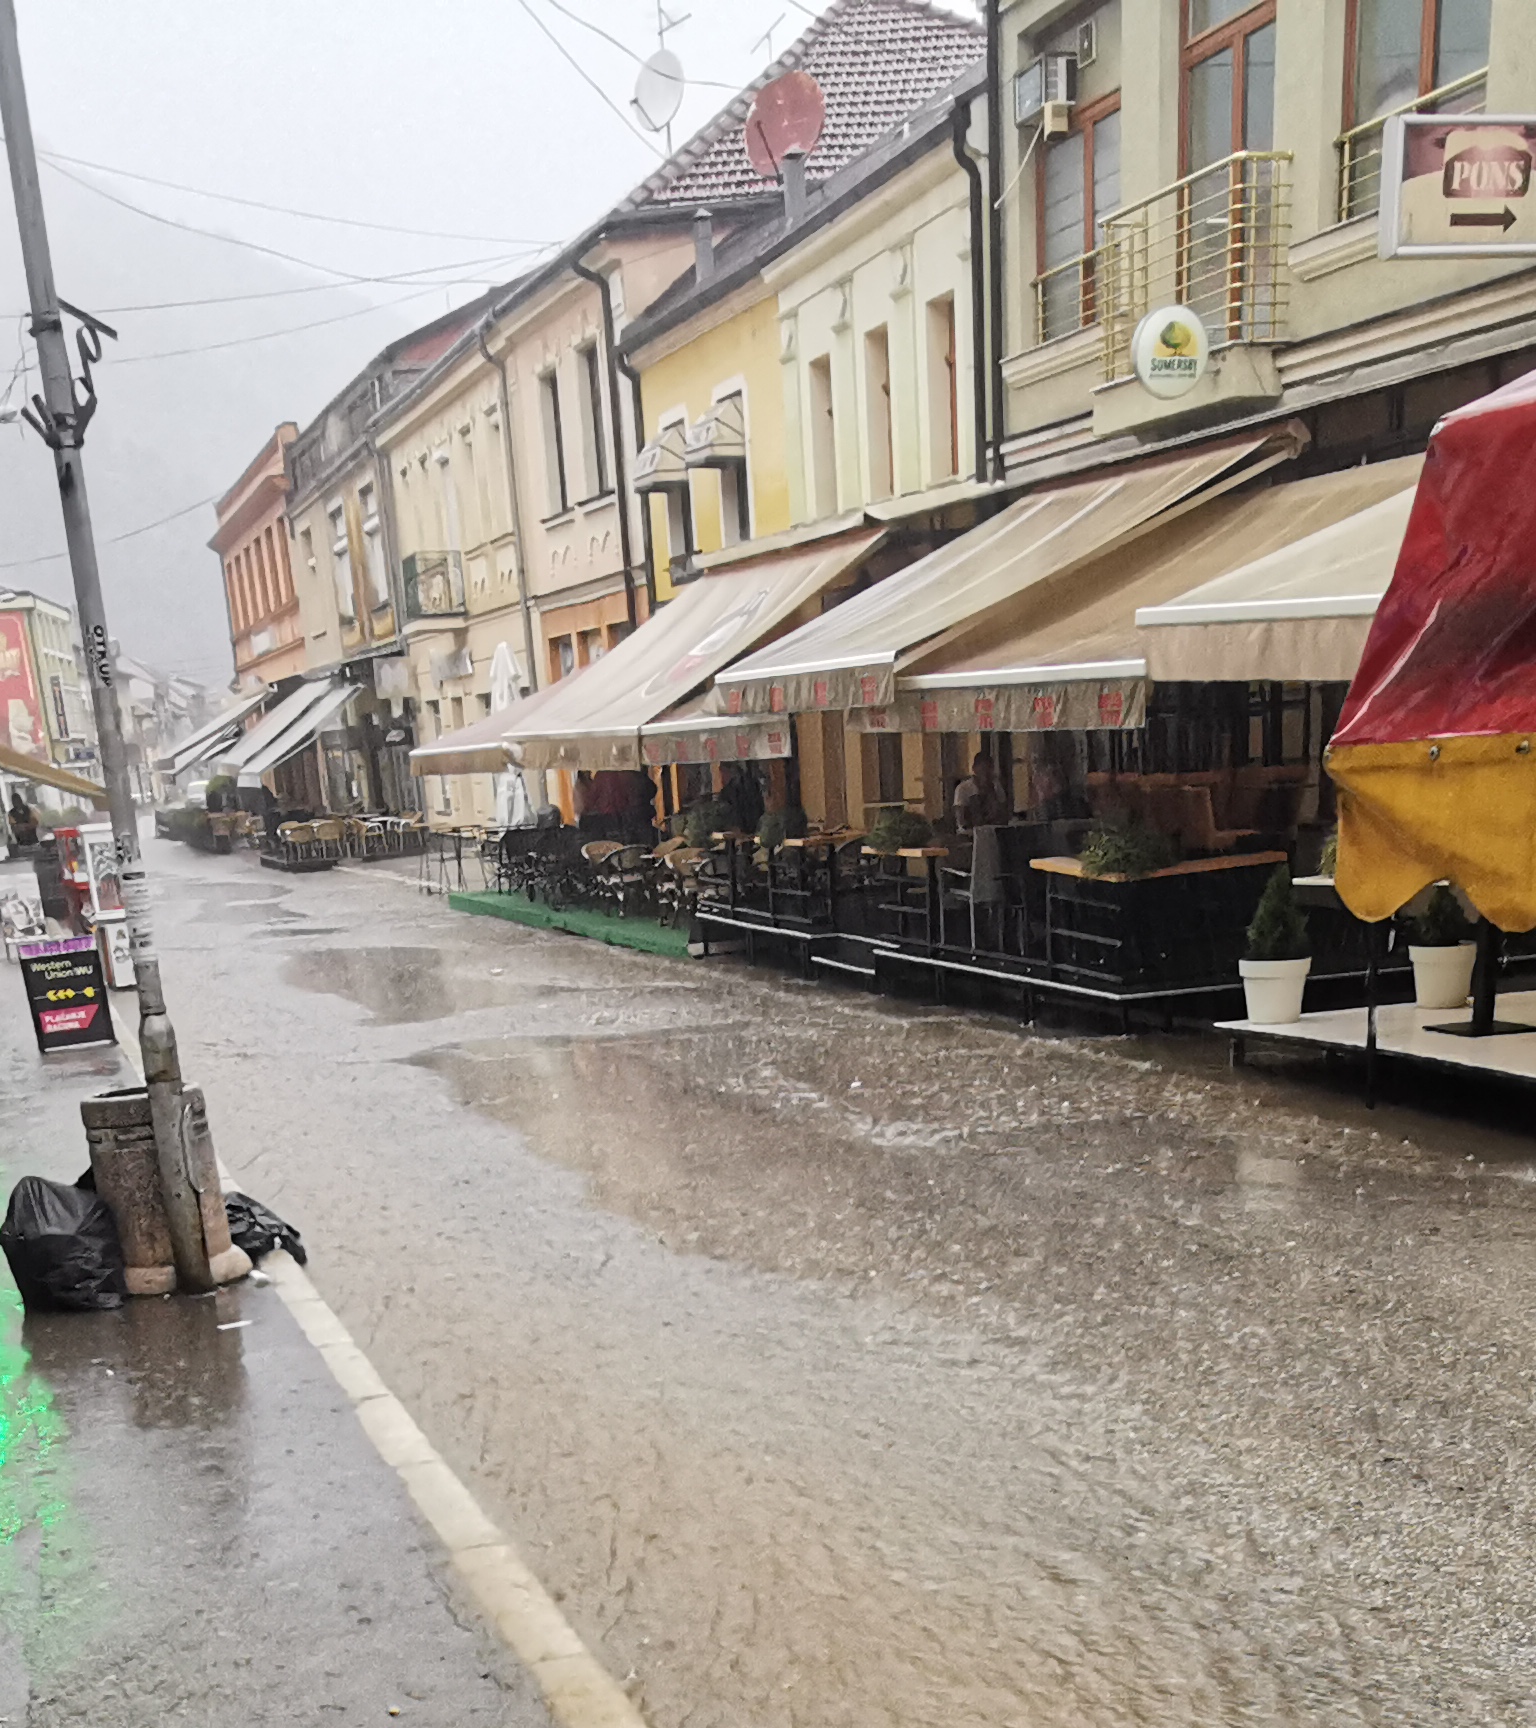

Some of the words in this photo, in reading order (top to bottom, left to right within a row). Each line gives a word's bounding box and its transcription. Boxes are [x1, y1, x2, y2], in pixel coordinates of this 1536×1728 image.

[1451, 160, 1525, 192] PONS
[29, 960, 72, 972] Western
[44, 969, 74, 980] Union
